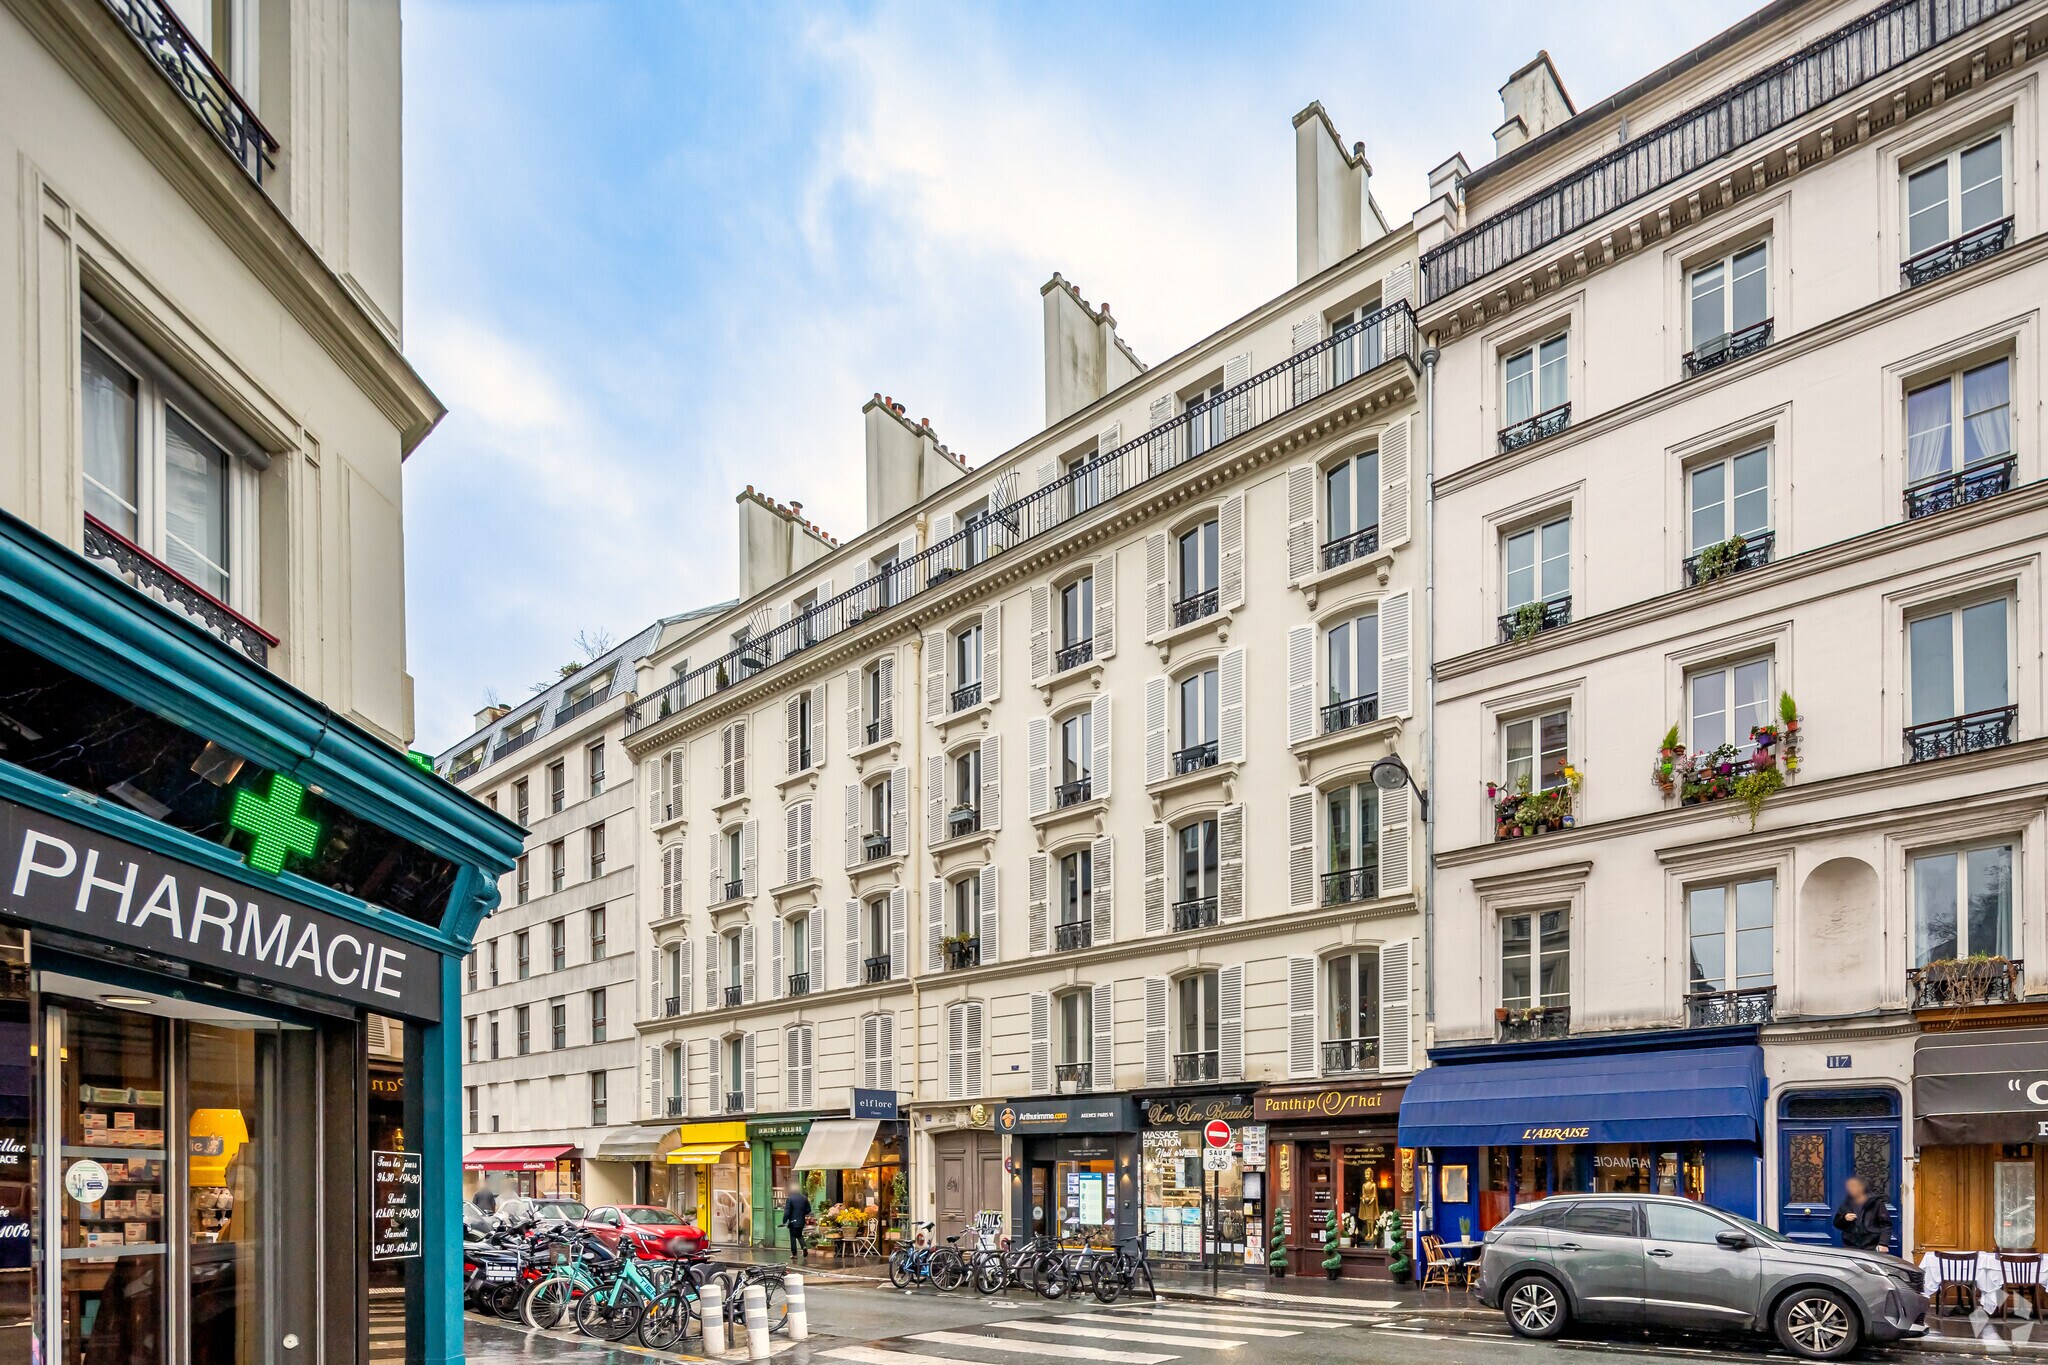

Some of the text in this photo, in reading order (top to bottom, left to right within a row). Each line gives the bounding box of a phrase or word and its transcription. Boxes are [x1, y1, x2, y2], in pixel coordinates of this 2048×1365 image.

[13, 829, 406, 998] PHARMACIE
[1829, 1056, 1849, 1068] 117
[860, 1099, 892, 1109] elflore
[1265, 1097, 1316, 1112] Panthip
[1020, 1112, 1067, 1121] Arthurimmo.com
[1142, 1131, 1179, 1139] MASSAGE
[1522, 1127, 1589, 1140] L'ABRAISE
[1142, 1139, 1182, 1148] EPILATION
[1155, 1148, 1172, 1158] Nail
[377, 1156, 392, 1167] Tous
[401, 1159, 417, 1172] jours
[387, 1193, 407, 1204] Lundi
[976, 1214, 1001, 1228] NAILS
[384, 1227, 408, 1239] Samedi
